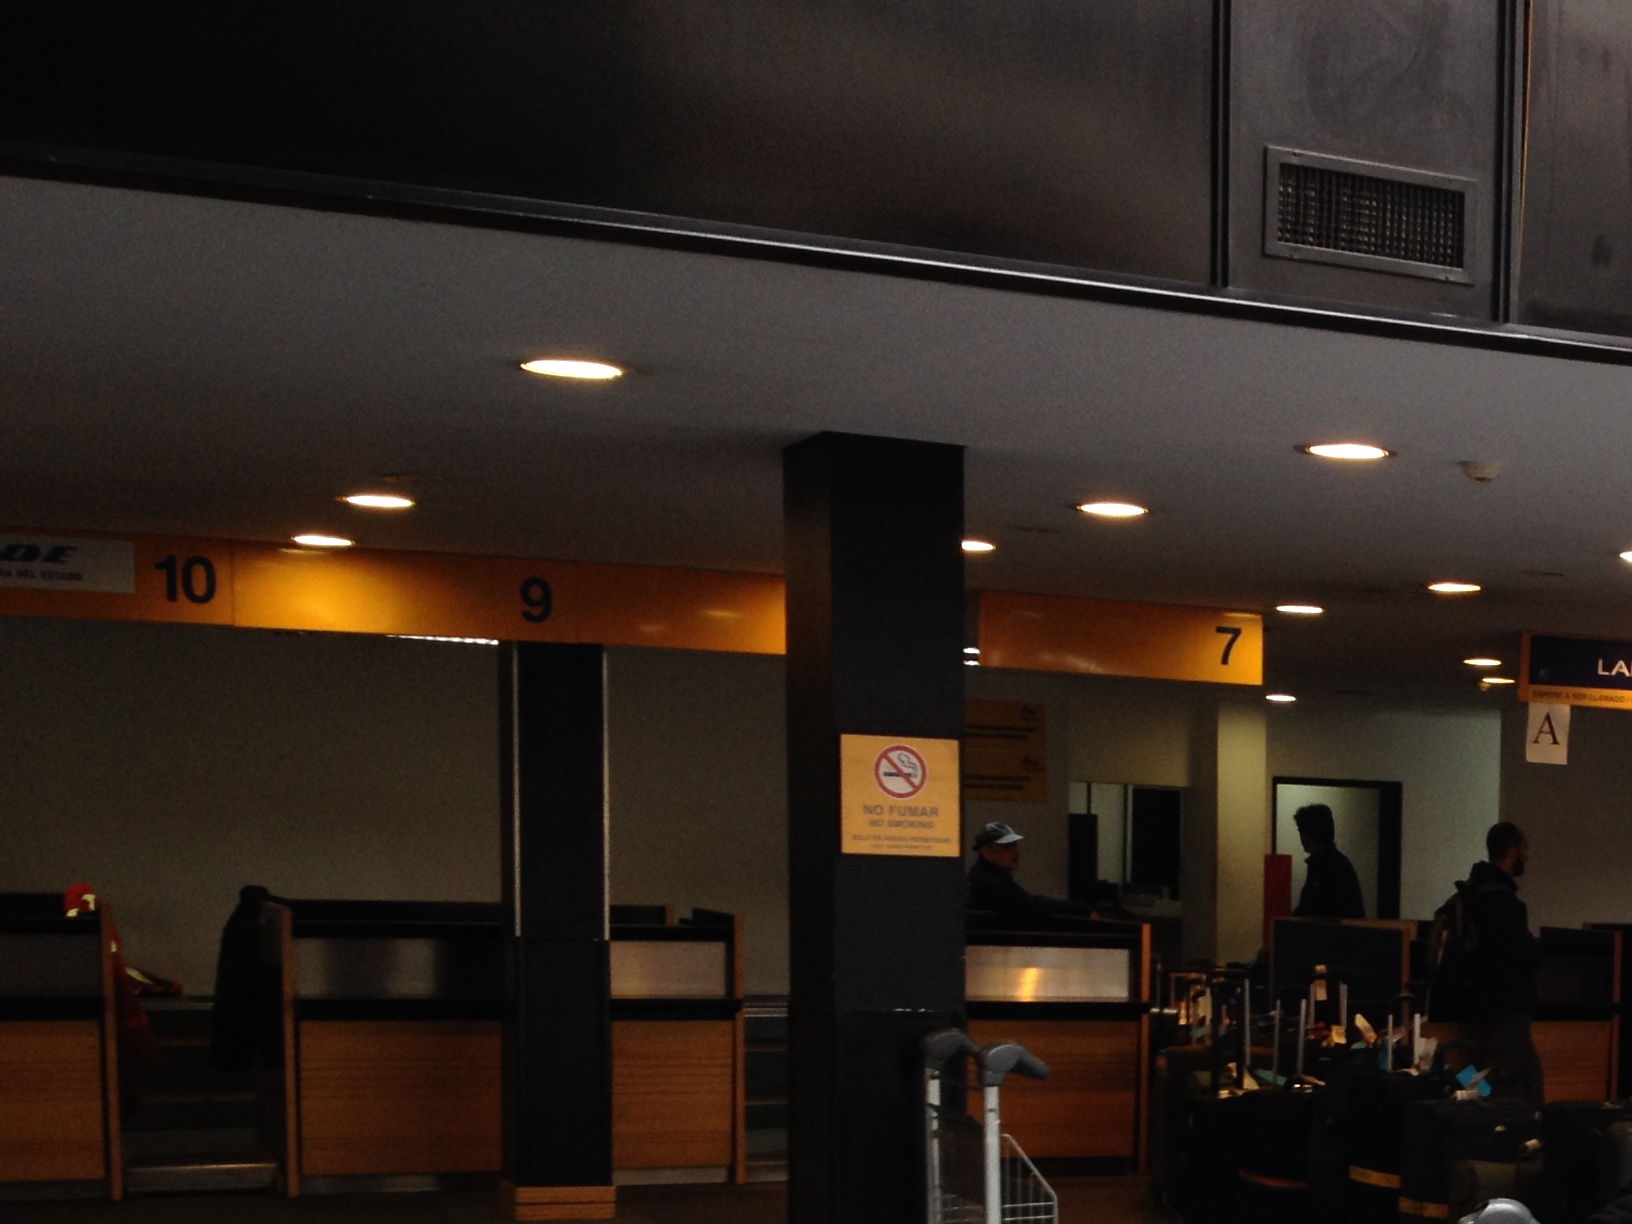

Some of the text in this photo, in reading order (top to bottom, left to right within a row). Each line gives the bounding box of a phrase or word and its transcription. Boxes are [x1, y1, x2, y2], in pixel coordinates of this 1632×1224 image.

[154, 555, 216, 603] 10
[521, 576, 552, 623] 9
[1216, 626, 1241, 666] 7
[1532, 712, 1561, 746] A
[863, 804, 940, 818] NO FUMAR
